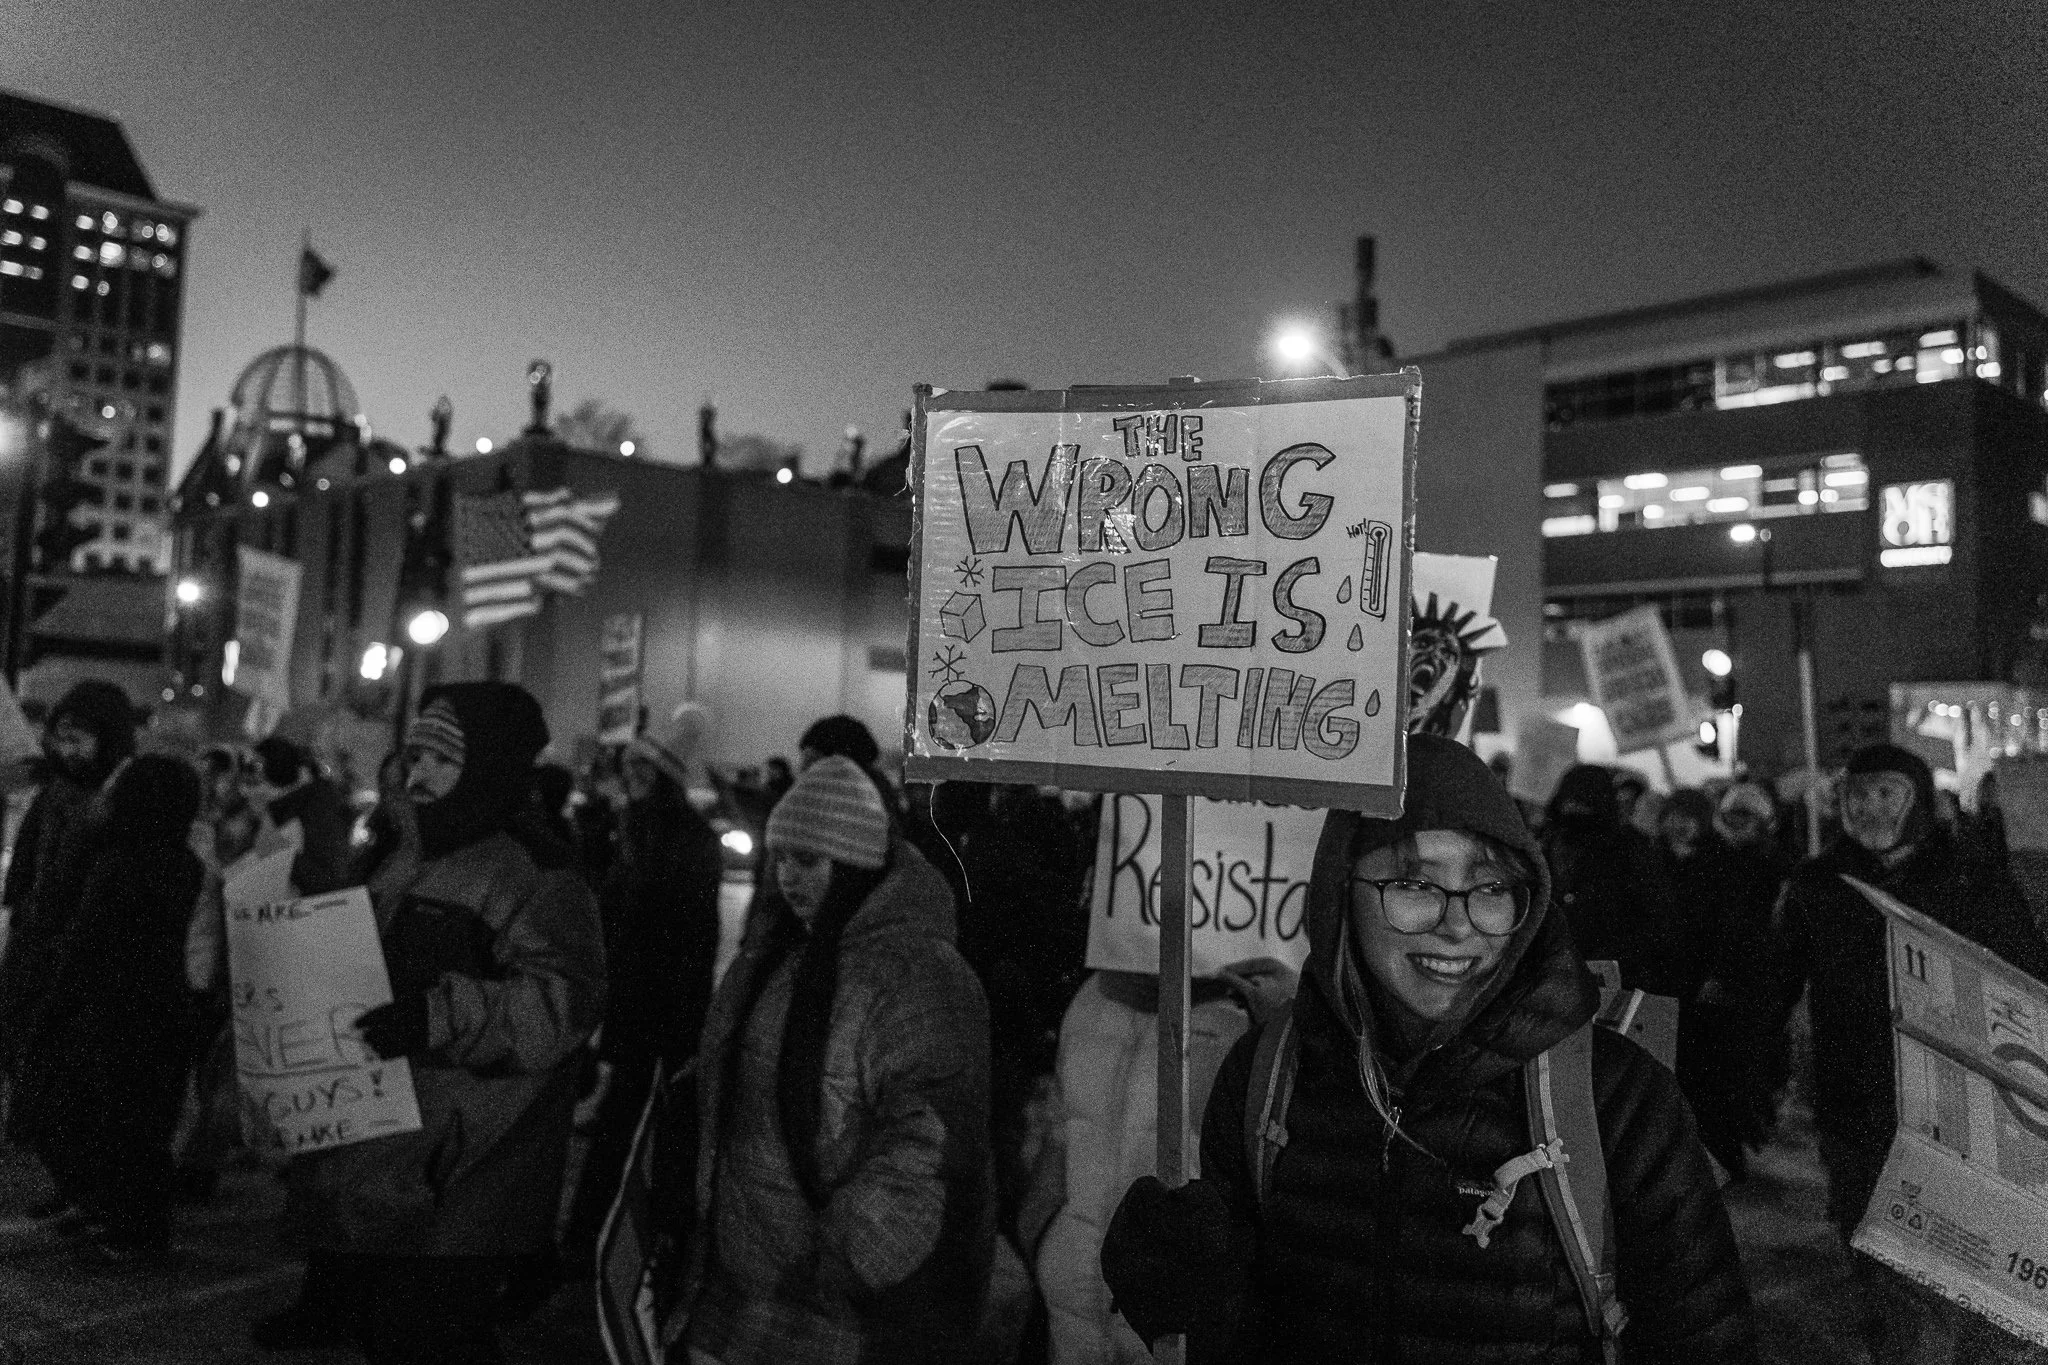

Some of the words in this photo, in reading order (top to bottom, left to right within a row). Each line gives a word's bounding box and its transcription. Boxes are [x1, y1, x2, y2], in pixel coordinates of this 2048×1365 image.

[1114, 414, 1203, 461] THE
[954, 442, 1336, 554] WRONG
[992, 559, 1176, 653] ICE
[1198, 556, 1327, 653] IS
[993, 663, 1360, 760] MELTING
